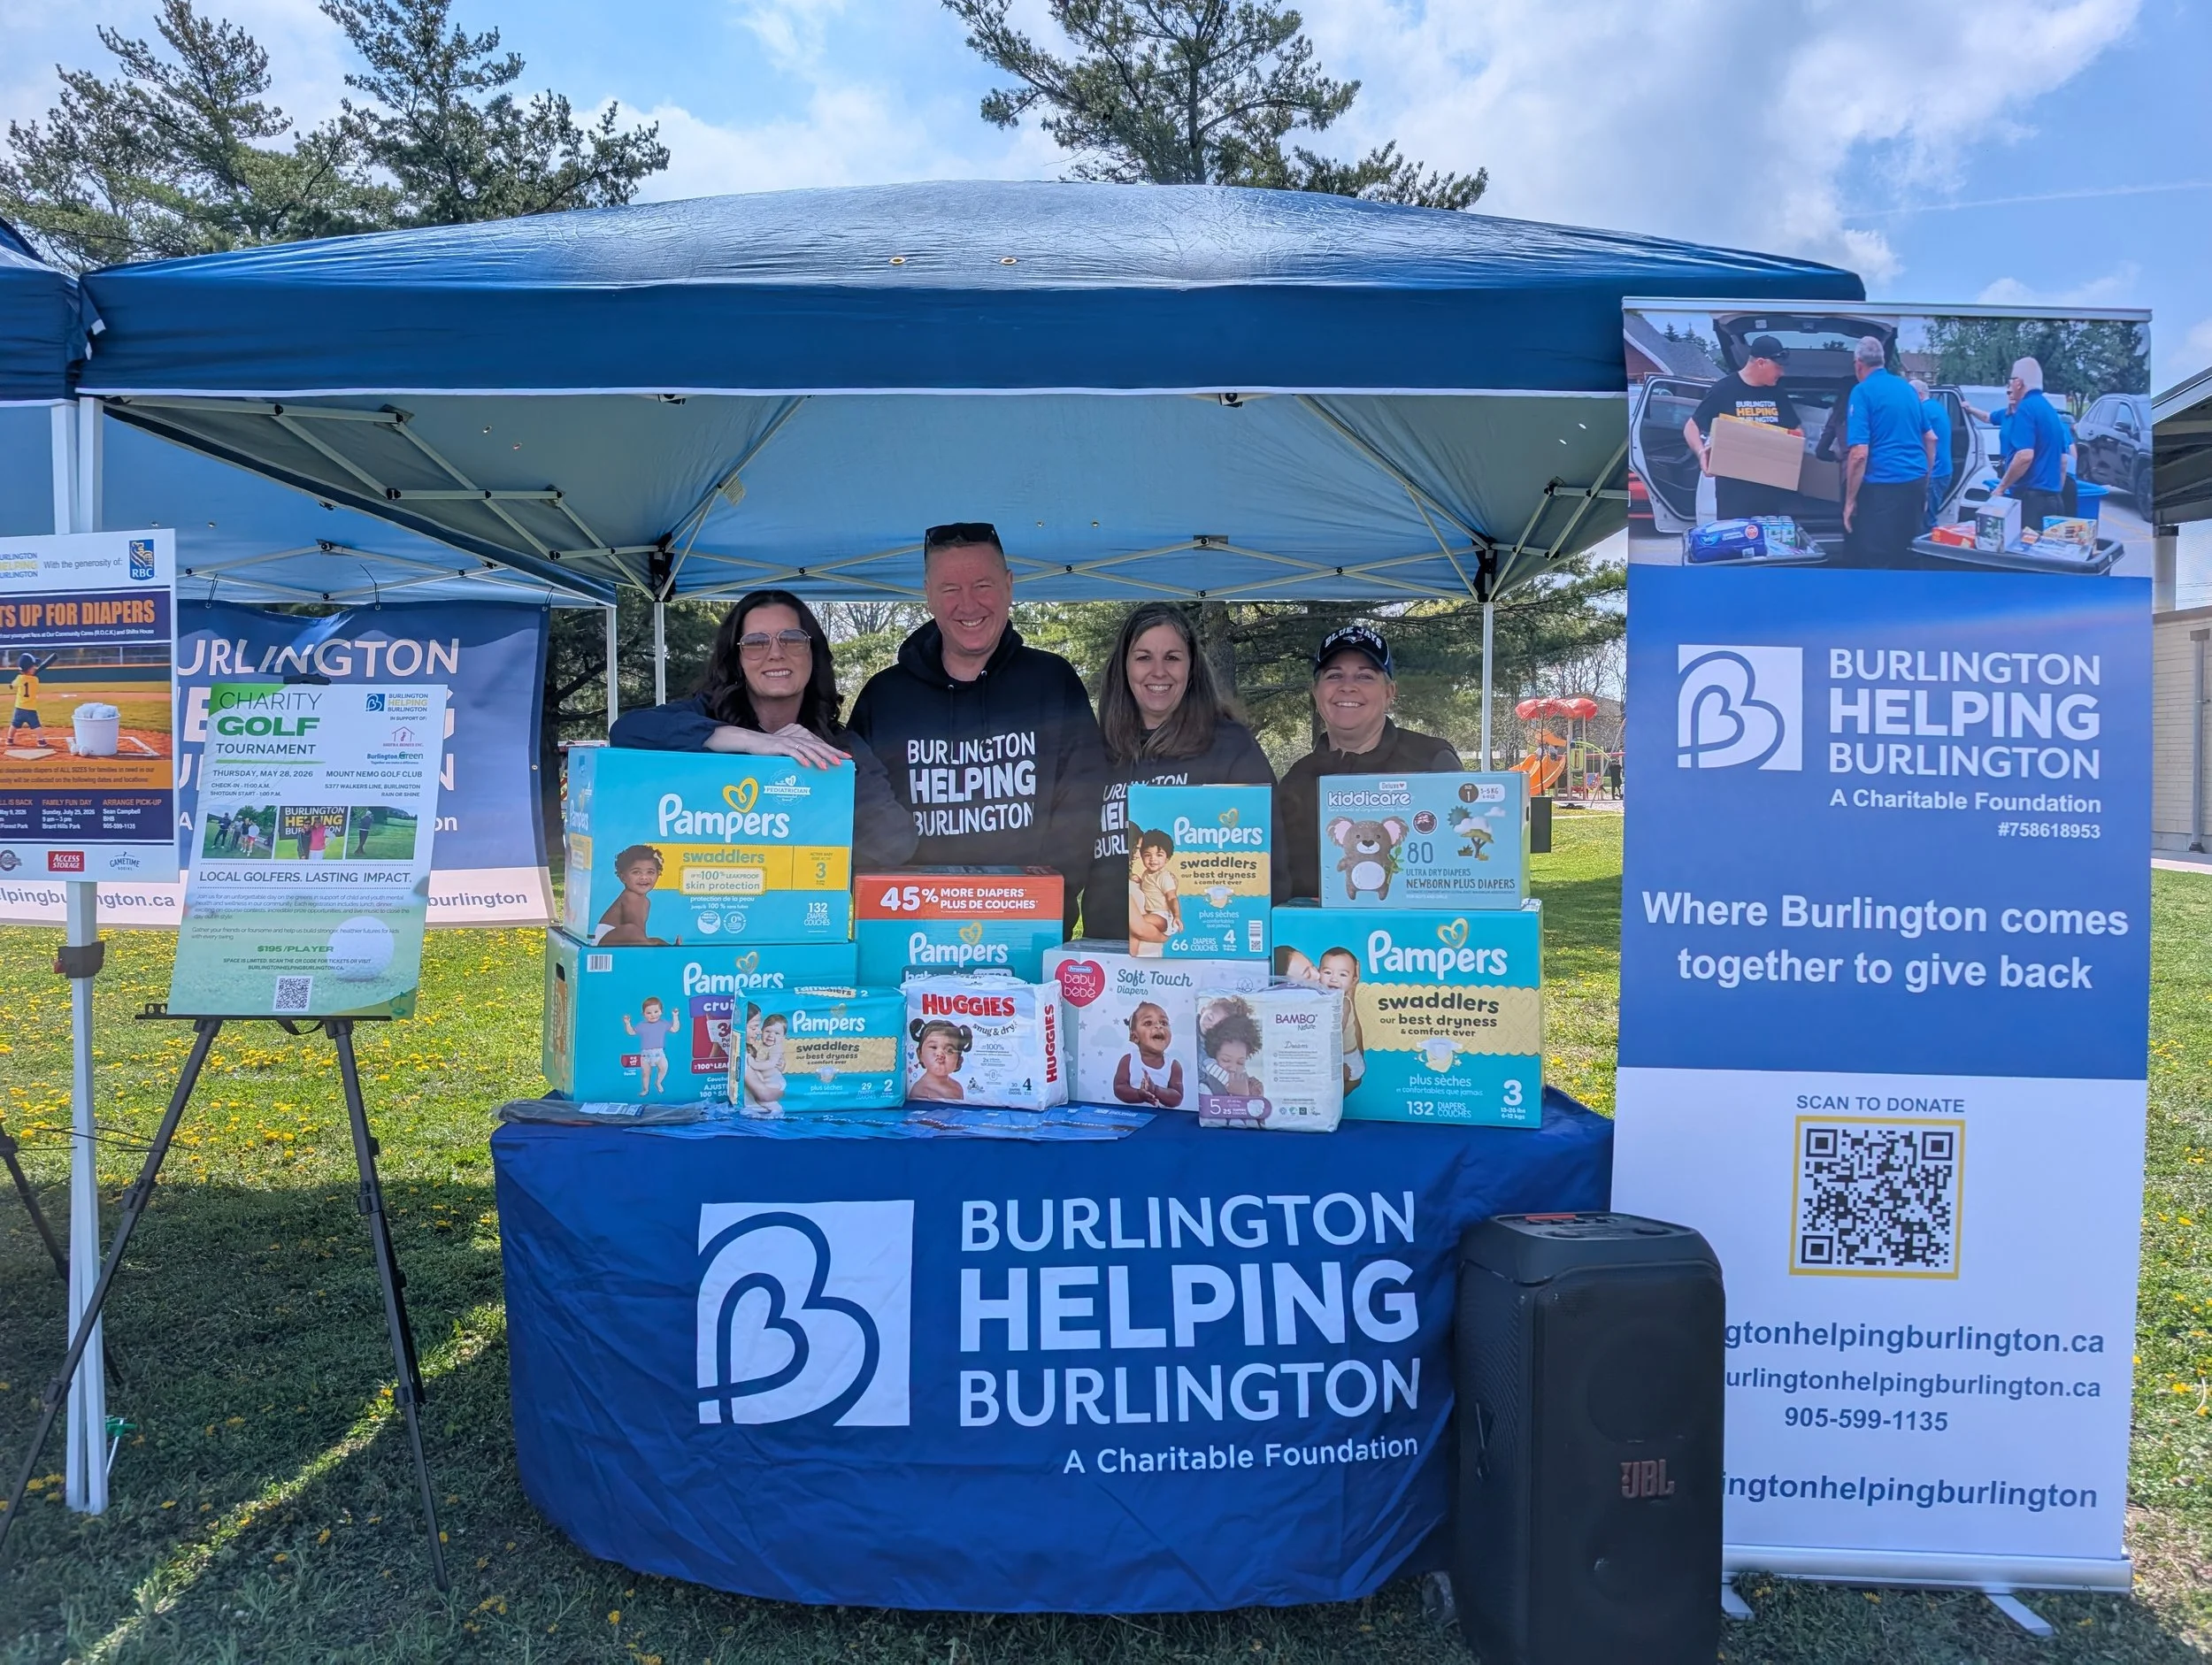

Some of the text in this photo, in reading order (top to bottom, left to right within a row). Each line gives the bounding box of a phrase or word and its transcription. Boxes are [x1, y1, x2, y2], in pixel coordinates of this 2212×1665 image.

[1736, 407, 1778, 417] HELPING
[74, 558, 111, 570] generosity
[132, 568, 153, 578] RBC
[19, 599, 155, 627] UP FOR DIAPERS
[1324, 626, 1382, 648] BLUE JAYS
[1830, 648, 2101, 686] BURLINGTON
[23, 682, 29, 697] 1
[219, 692, 322, 710] CHARITY
[1830, 687, 2101, 740] HELPING
[217, 716, 320, 737] GOLF
[216, 743, 316, 755] TOURNAMENT
[908, 732, 1035, 764] BURLINGTON
[1830, 742, 2101, 779] BURLINGTON
[910, 760, 1036, 804] HELPING
[1327, 790, 1411, 808] kiddicare
[1829, 789, 2102, 813] A Charitable Foundation
[285, 806, 345, 816] BURLINGTON
[658, 794, 790, 843] Pampers
[913, 802, 1034, 836] BURLINGTON
[1173, 817, 1263, 849] Pampers
[1998, 821, 2101, 839] #758618953
[53, 854, 81, 863] ACCESS
[682, 849, 765, 863] swaddlers
[1408, 841, 1433, 864] 80
[110, 857, 141, 869] GAMETIME
[816, 863, 827, 879] 3
[1179, 856, 1257, 871] swaddlers
[200, 871, 412, 883] LOCAL GOLFERS. LASTING IMPACT.
[1193, 871, 1215, 879] best
[1217, 871, 1256, 881] dryness
[1406, 868, 1471, 877] ULTRA DRY DIAPERS
[686, 880, 761, 892] skin protection
[941, 888, 974, 897] MORE
[1406, 879, 1516, 889] NEWBORN PLUS DIAPERS
[879, 886, 940, 911] 45%
[941, 900, 967, 909] PLUS
[969, 900, 983, 909] DE
[809, 902, 828, 913] 132
[1199, 910, 1214, 920] plus
[1642, 890, 2129, 939] Where Burlington comes
[1171, 939, 1189, 951] 66
[1224, 929, 1236, 944] 4
[909, 932, 1009, 968] Pampers
[1368, 930, 1508, 981] Pampers
[683, 962, 785, 996] Pampers
[1064, 972, 1096, 987] baby
[1117, 969, 1194, 987] Soft Touch
[1678, 949, 2093, 993] together to give back
[1117, 986, 1148, 996] Diapers
[922, 994, 1016, 1017] HUGGIES
[1378, 992, 1500, 1014] swaddlers
[792, 1010, 866, 1035] Pampers
[1275, 1014, 1316, 1024] BAMBO
[1398, 1013, 1432, 1025] best
[1436, 1015, 1498, 1031] dryness
[973, 1024, 992, 1037] snug
[1000, 1024, 1016, 1035] dry
[1408, 1027, 1450, 1036] comfort
[796, 1041, 860, 1053] swaddlers
[1044, 1003, 1058, 1083] HUGGIES
[884, 1078, 894, 1093] 2
[1022, 1078, 1033, 1092] 4
[1409, 1073, 1472, 1087] plus sèches
[1402, 1086, 1445, 1095] confortables
[1503, 1078, 1523, 1107] 3
[1210, 1099, 1222, 1115] 5
[1407, 1101, 1434, 1116] 132
[1437, 1101, 1466, 1110] DIAPERS
[1796, 1095, 1966, 1114] SCAN TO DONATE
[1437, 1109, 1472, 1118] COUCHES
[961, 1192, 1416, 1252] BURLINGTON
[960, 1260, 1420, 1352] HELPING
[959, 1357, 1421, 1427] BURLINGTON
[1785, 1408, 1948, 1431] 905-599-1135
[1063, 1437, 1419, 1475] A Charitable Foundation
[1620, 1459, 1675, 1499] JBL
